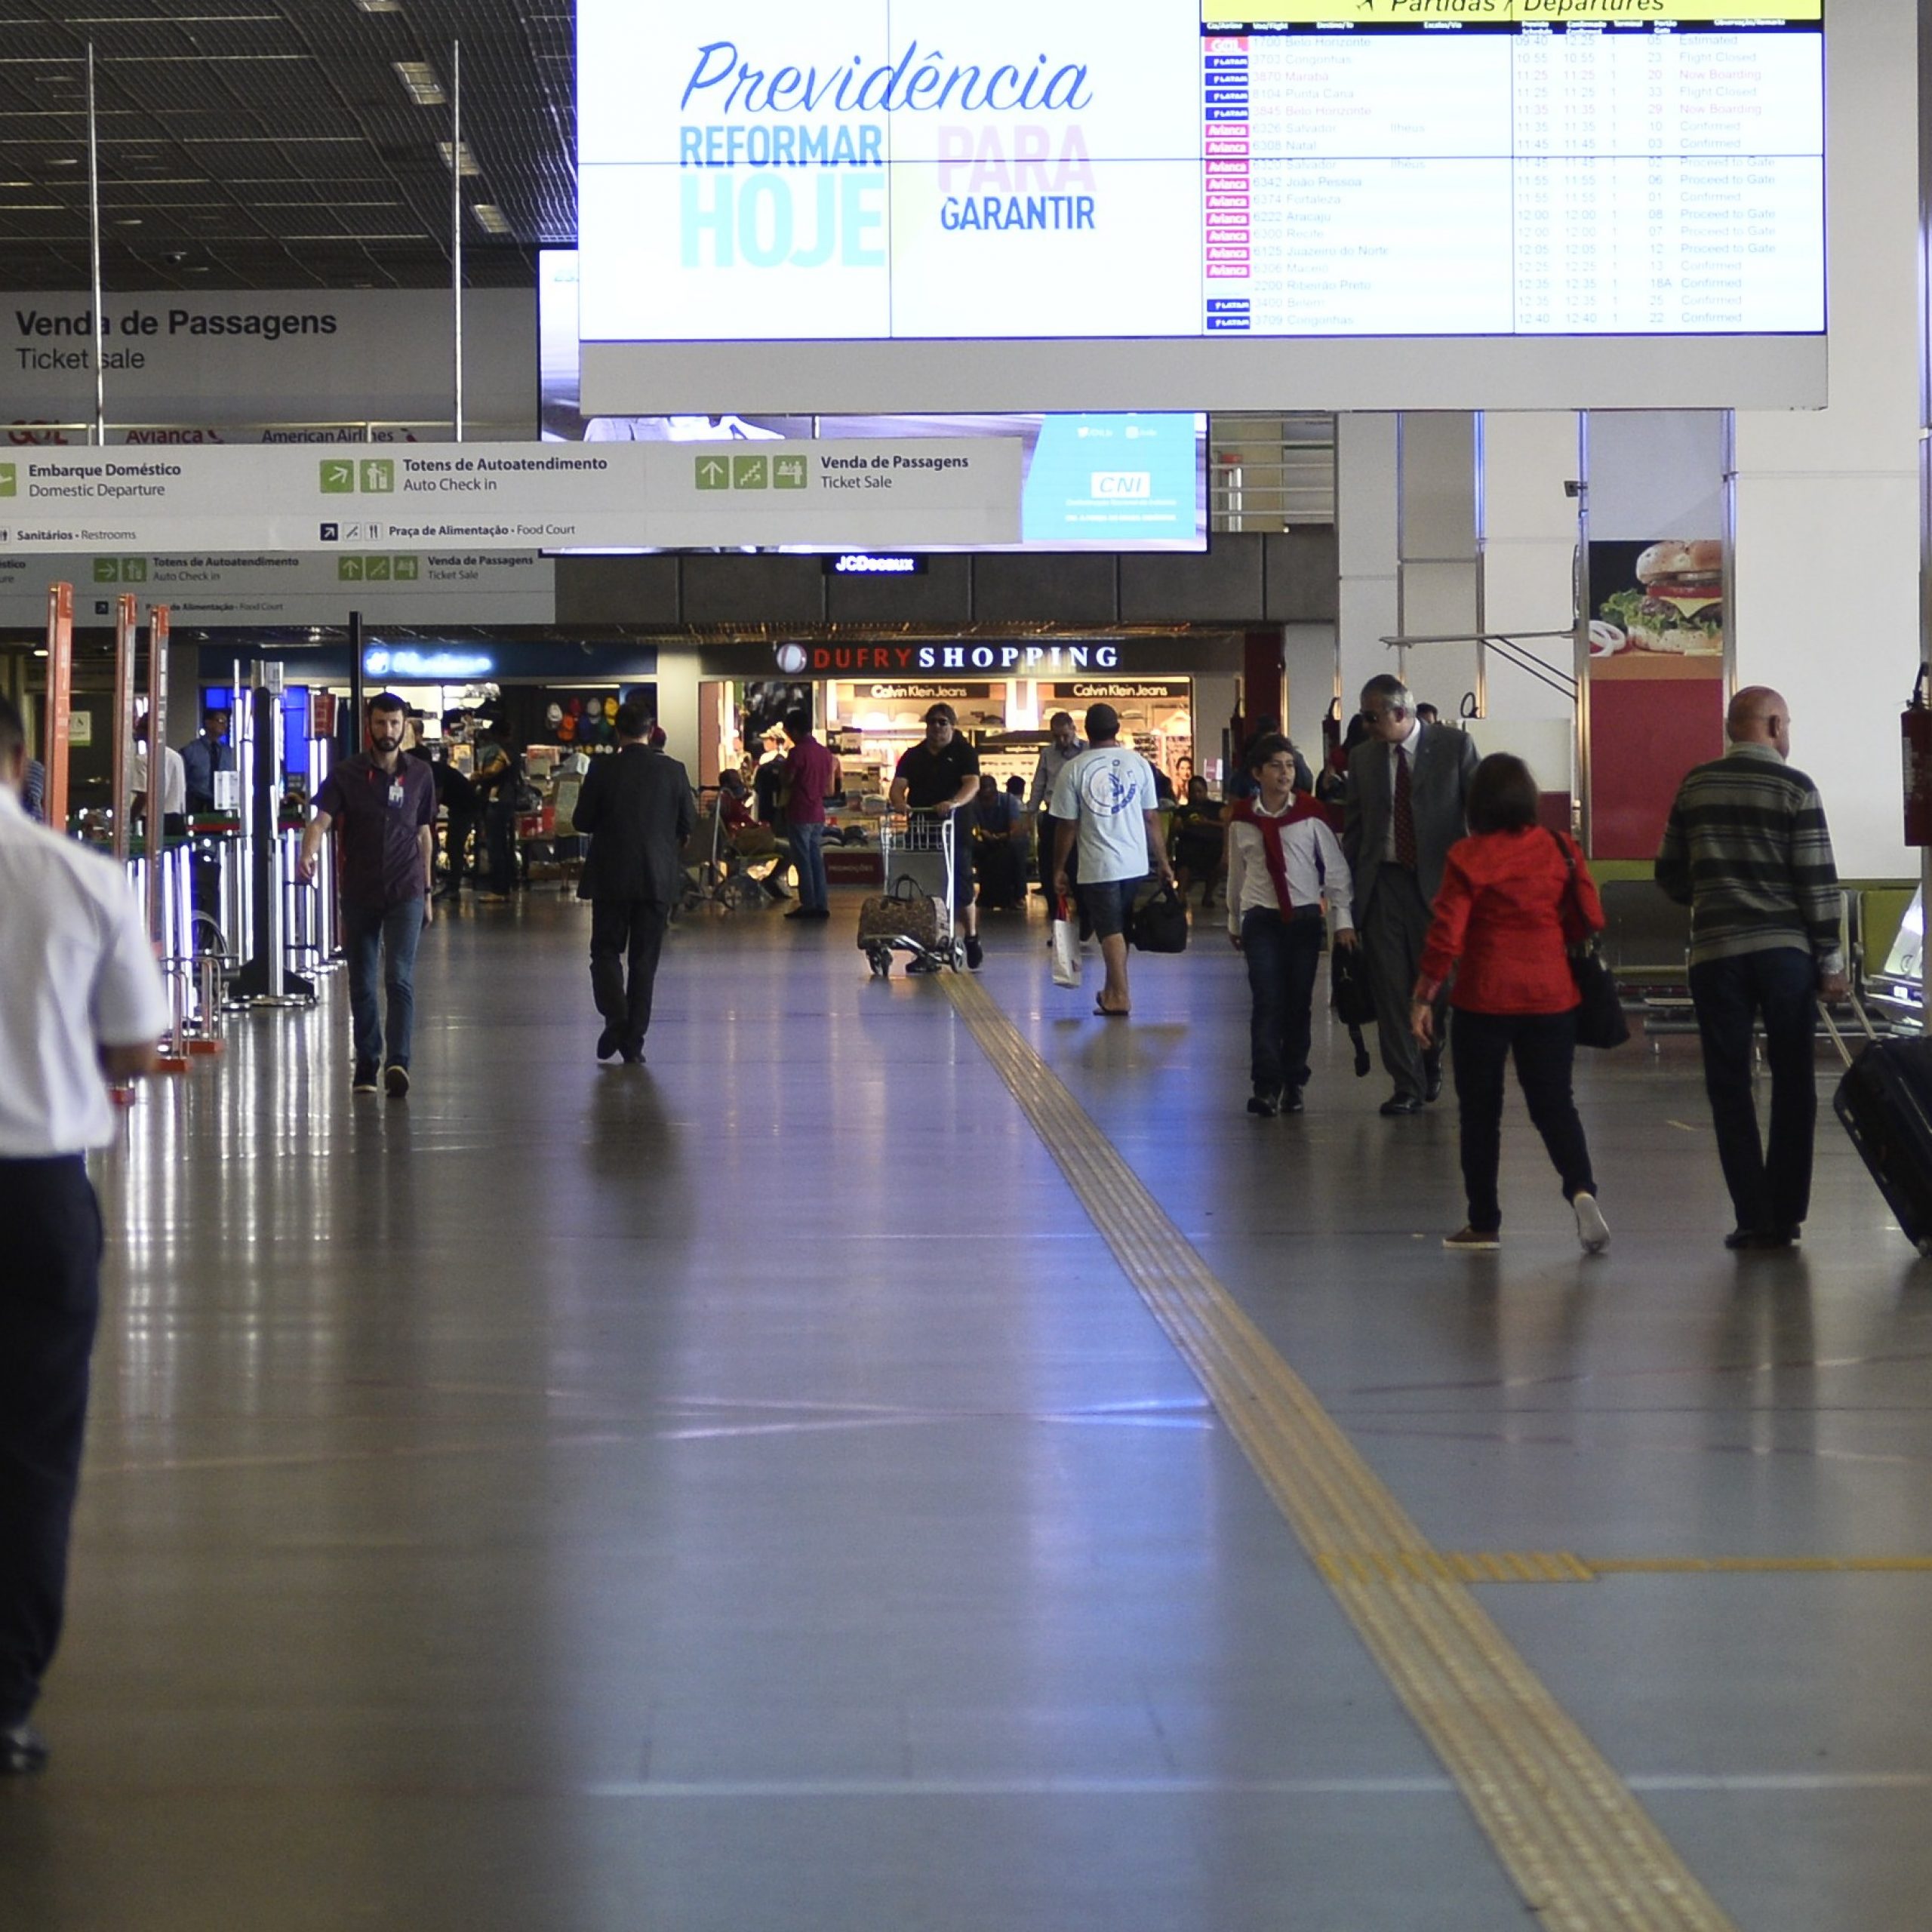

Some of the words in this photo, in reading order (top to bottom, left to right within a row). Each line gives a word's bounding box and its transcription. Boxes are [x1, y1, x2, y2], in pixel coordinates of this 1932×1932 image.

[1524, 0, 1664, 15] Departures
[681, 40, 1093, 115] Previdência
[1679, 70, 1706, 80] Now
[1709, 70, 1761, 82] Boarding
[1680, 104, 1706, 114] Now
[1709, 104, 1761, 116] Boarding
[680, 125, 883, 168] REFORMAR
[937, 125, 1097, 193] PARA
[1733, 175, 1744, 184] to
[1747, 175, 1775, 184] Gate
[941, 195, 1096, 231] GARANTIR
[1734, 210, 1744, 219] to
[1747, 210, 1776, 219] Gate
[680, 173, 886, 269] HOJE
[1734, 245, 1744, 254] to
[1748, 245, 1776, 254] Gate
[121, 309, 158, 337] de
[168, 309, 337, 340] Passagens
[17, 348, 89, 369] Ticket
[100, 348, 145, 369] sale
[126, 428, 204, 444] Avianca
[263, 429, 334, 443] American
[337, 429, 394, 443] Airlnes
[403, 458, 451, 472] Totens
[455, 457, 473, 471] de
[477, 457, 608, 471] Autoatendimento
[821, 455, 868, 469] Venda
[871, 455, 889, 469] de
[894, 455, 969, 471] Passagens
[29, 464, 102, 479] Embarque
[106, 462, 181, 476] Doméstico
[403, 478, 436, 491] Auto
[439, 477, 481, 491] Check
[484, 478, 497, 491] in
[822, 475, 861, 489] Ticket
[865, 475, 892, 489] Sale
[1099, 476, 1142, 494] CNI
[29, 483, 94, 497] Domestic
[97, 483, 166, 499] Departure
[17, 530, 73, 541] Sanitários
[81, 530, 137, 540] Restrooms
[389, 525, 419, 537] Praça
[422, 525, 436, 536] de
[438, 525, 509, 537] Alimentação
[517, 525, 544, 535] Food
[546, 525, 576, 535] Court
[153, 557, 187, 568] Totens
[191, 557, 204, 568] de
[206, 557, 300, 568] Autoatendimento
[428, 556, 461, 567] Venda
[463, 556, 477, 567] de
[479, 555, 534, 568] Passagens
[153, 571, 177, 581] Auto
[179, 571, 209, 581] Check
[428, 570, 456, 580] Ticket
[458, 570, 478, 580] Sale
[814, 648, 912, 669] DUFRY
[918, 646, 1118, 668] SHOPPING
[871, 684, 907, 698] Calvin
[908, 684, 935, 697] Klein
[936, 685, 968, 697] Jeans
[1073, 684, 1108, 697] Calvin
[1109, 684, 1136, 696] Klein
[1137, 684, 1168, 696] Jeans
